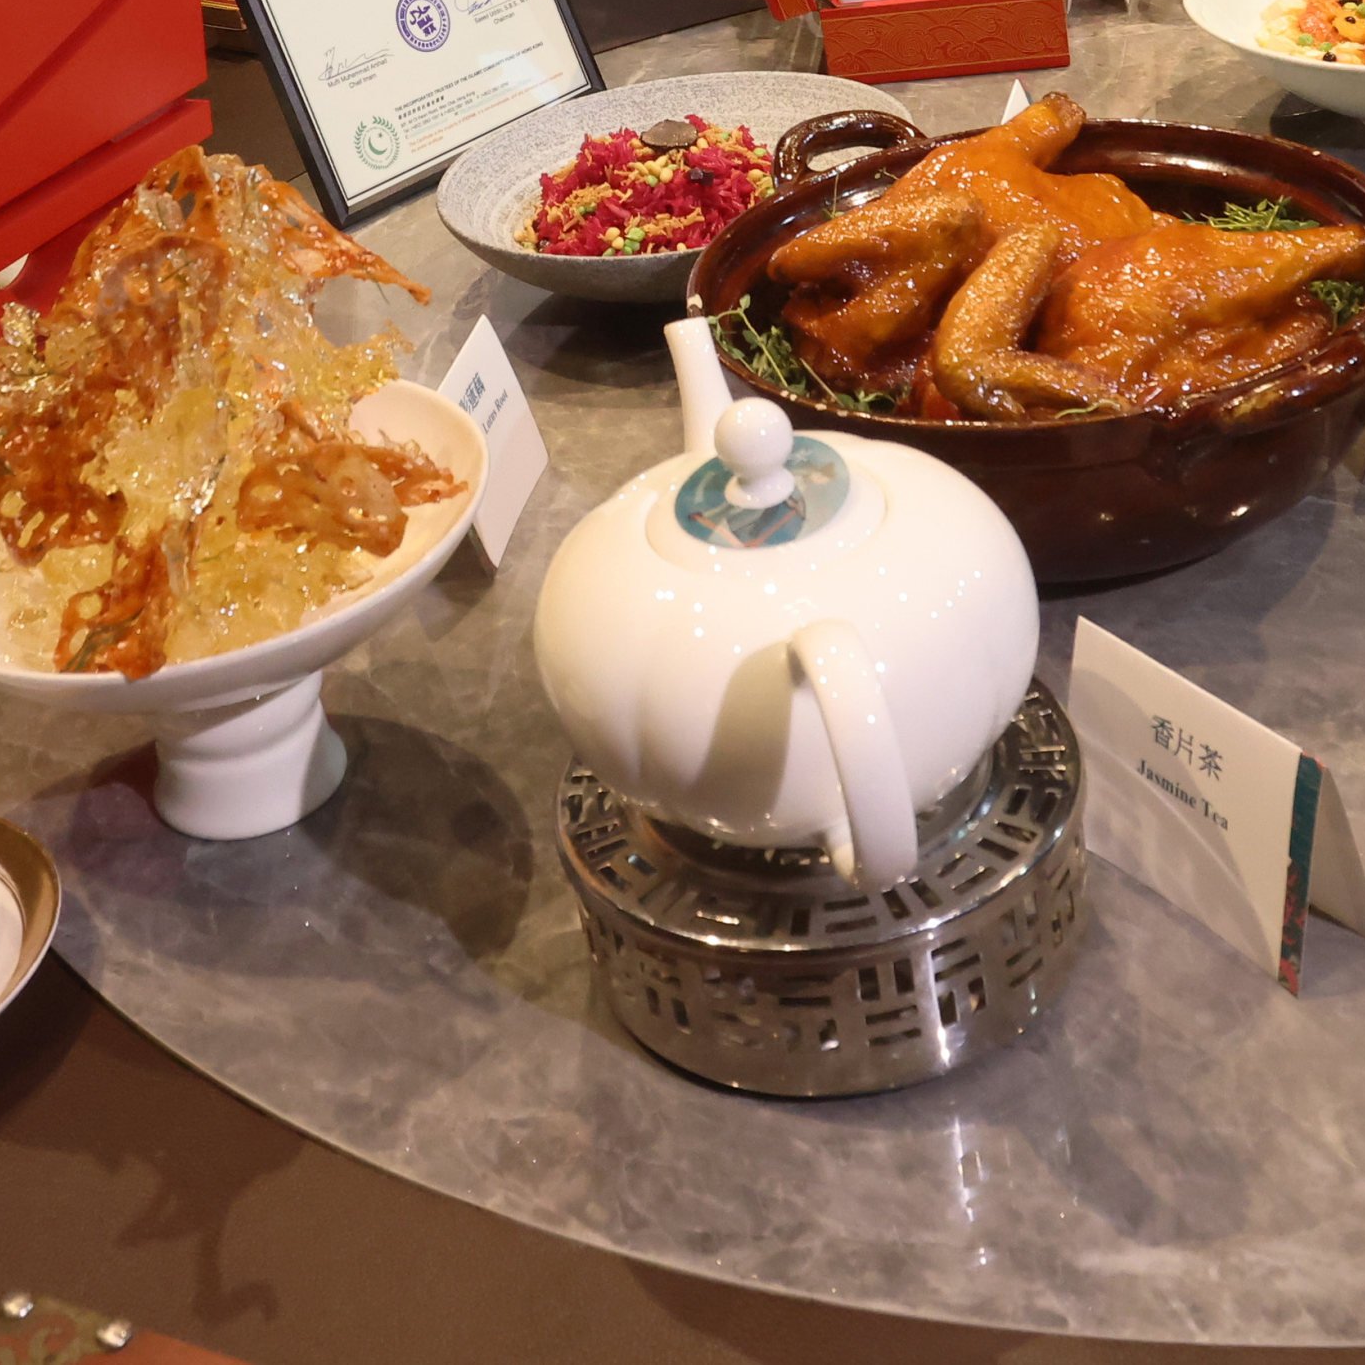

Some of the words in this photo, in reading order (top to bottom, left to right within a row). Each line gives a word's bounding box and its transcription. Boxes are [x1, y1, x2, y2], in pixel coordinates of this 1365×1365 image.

[495, 389, 509, 411] Root
[1151, 714, 1223, 782] 香片茶
[1136, 758, 1196, 810] Jasmine
[1201, 797, 1229, 831] Tea
